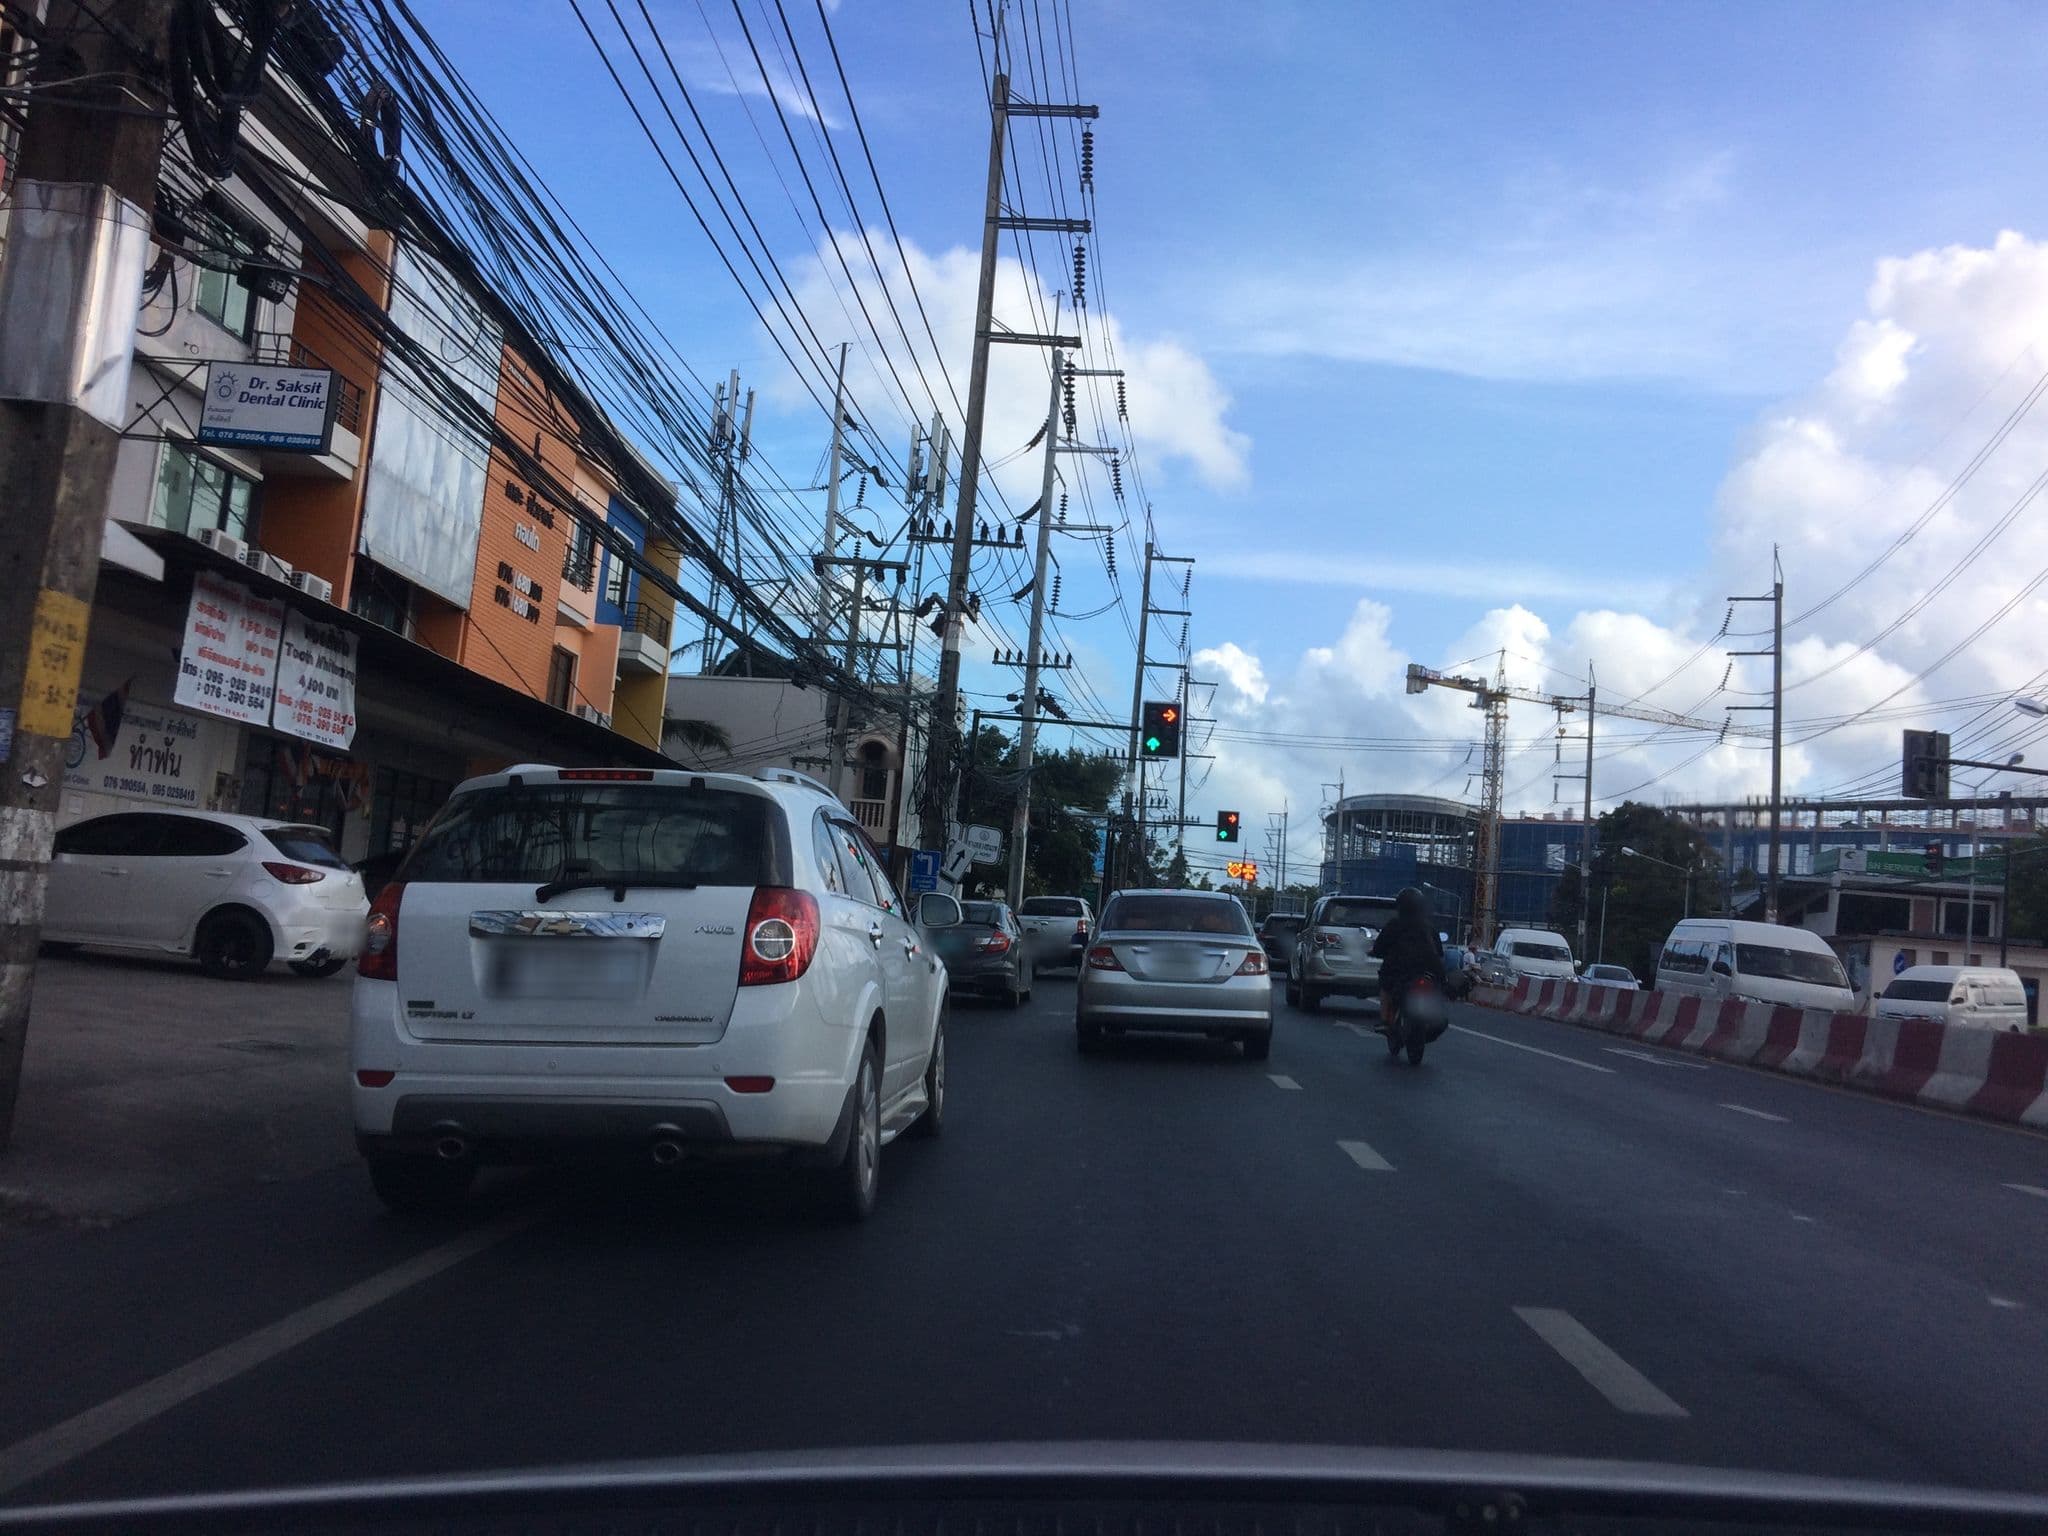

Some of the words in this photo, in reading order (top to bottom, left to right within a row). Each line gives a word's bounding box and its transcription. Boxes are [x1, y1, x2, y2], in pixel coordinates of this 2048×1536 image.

[248, 377, 270, 391] Dr.
[275, 379, 322, 394] Saksit
[238, 391, 285, 406] Dental
[288, 395, 326, 410] Clinic
[202, 430, 216, 439] Tel.
[218, 431, 234, 439] 076
[205, 669, 223, 684] 095
[204, 683, 222, 698] 076
[228, 690, 246, 705] 390
[248, 696, 265, 710] 554
[129, 733, 182, 778] ทำฟัน
[103, 775, 118, 789] 076
